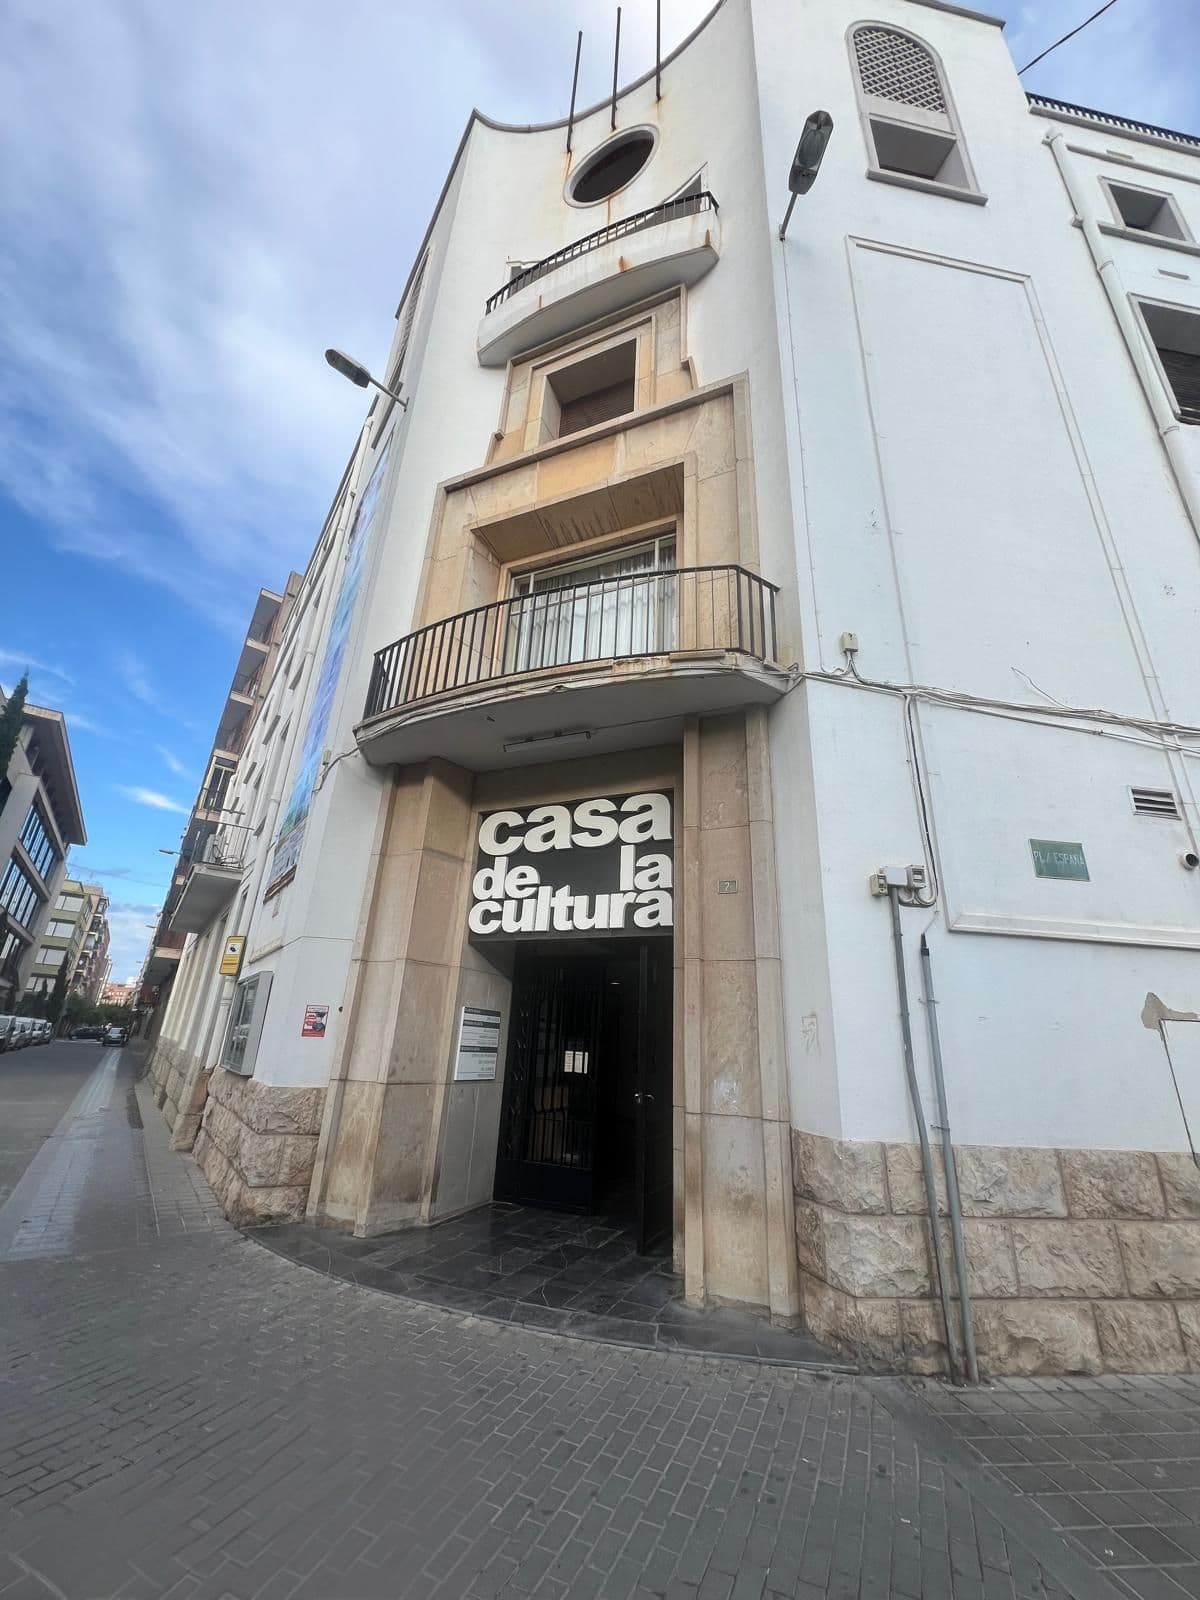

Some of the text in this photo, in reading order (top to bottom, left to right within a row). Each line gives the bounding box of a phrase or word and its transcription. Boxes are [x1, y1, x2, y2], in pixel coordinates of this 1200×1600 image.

[478, 793, 672, 856] casa
[472, 844, 673, 900] de la
[468, 885, 673, 934] cultura
